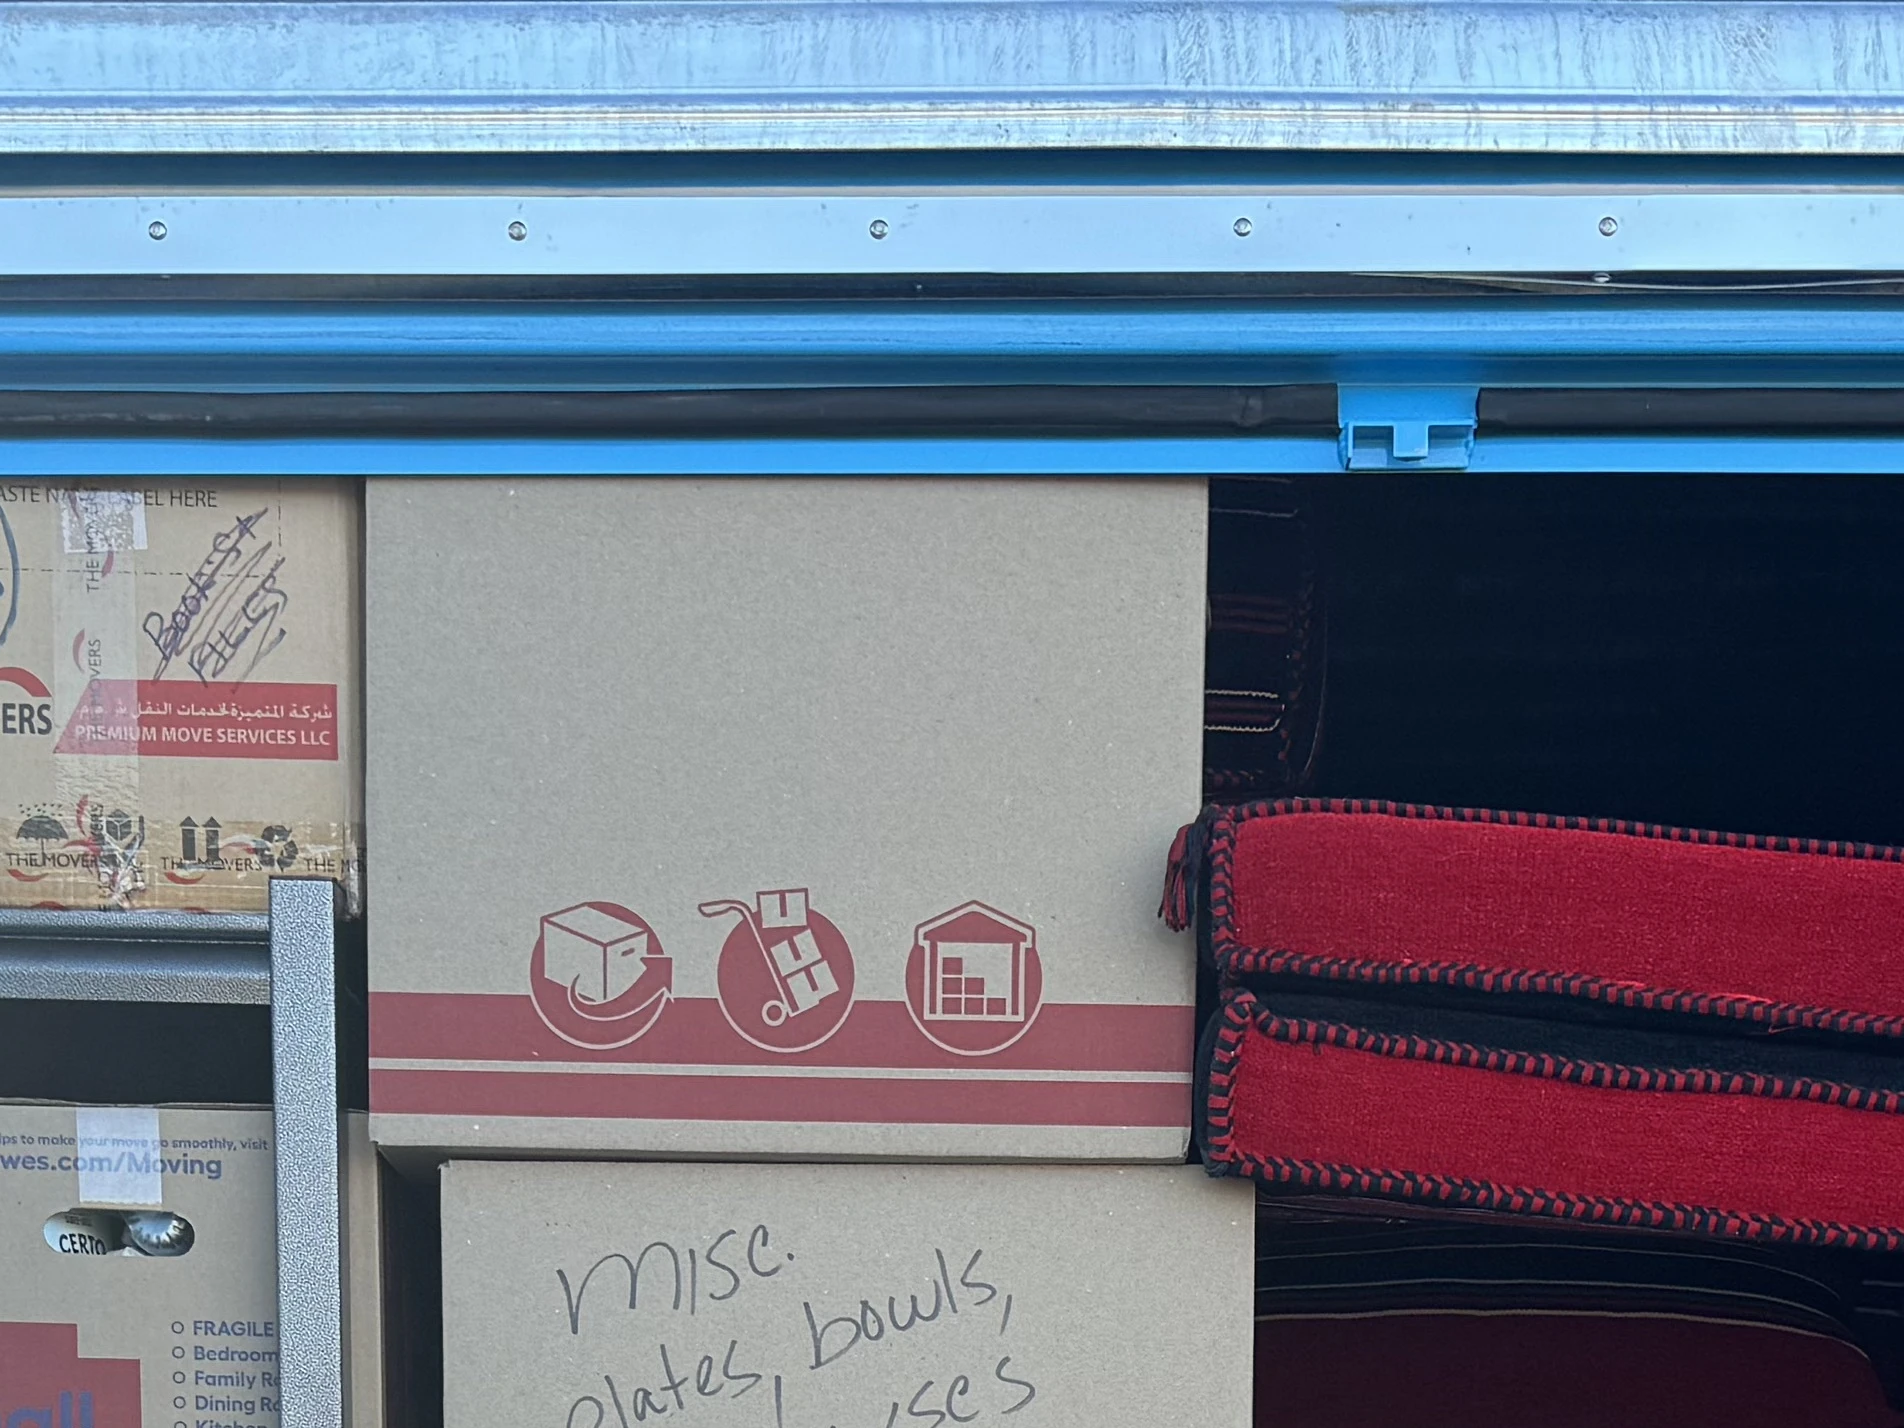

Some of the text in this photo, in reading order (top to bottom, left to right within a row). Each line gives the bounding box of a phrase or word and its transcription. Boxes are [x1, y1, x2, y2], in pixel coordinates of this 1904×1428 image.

[170, 489, 218, 508] HERE
[75, 724, 330, 746] PREMIUM MOVE SERVICES LLC
[803, 1247, 1016, 1371] bowls,
